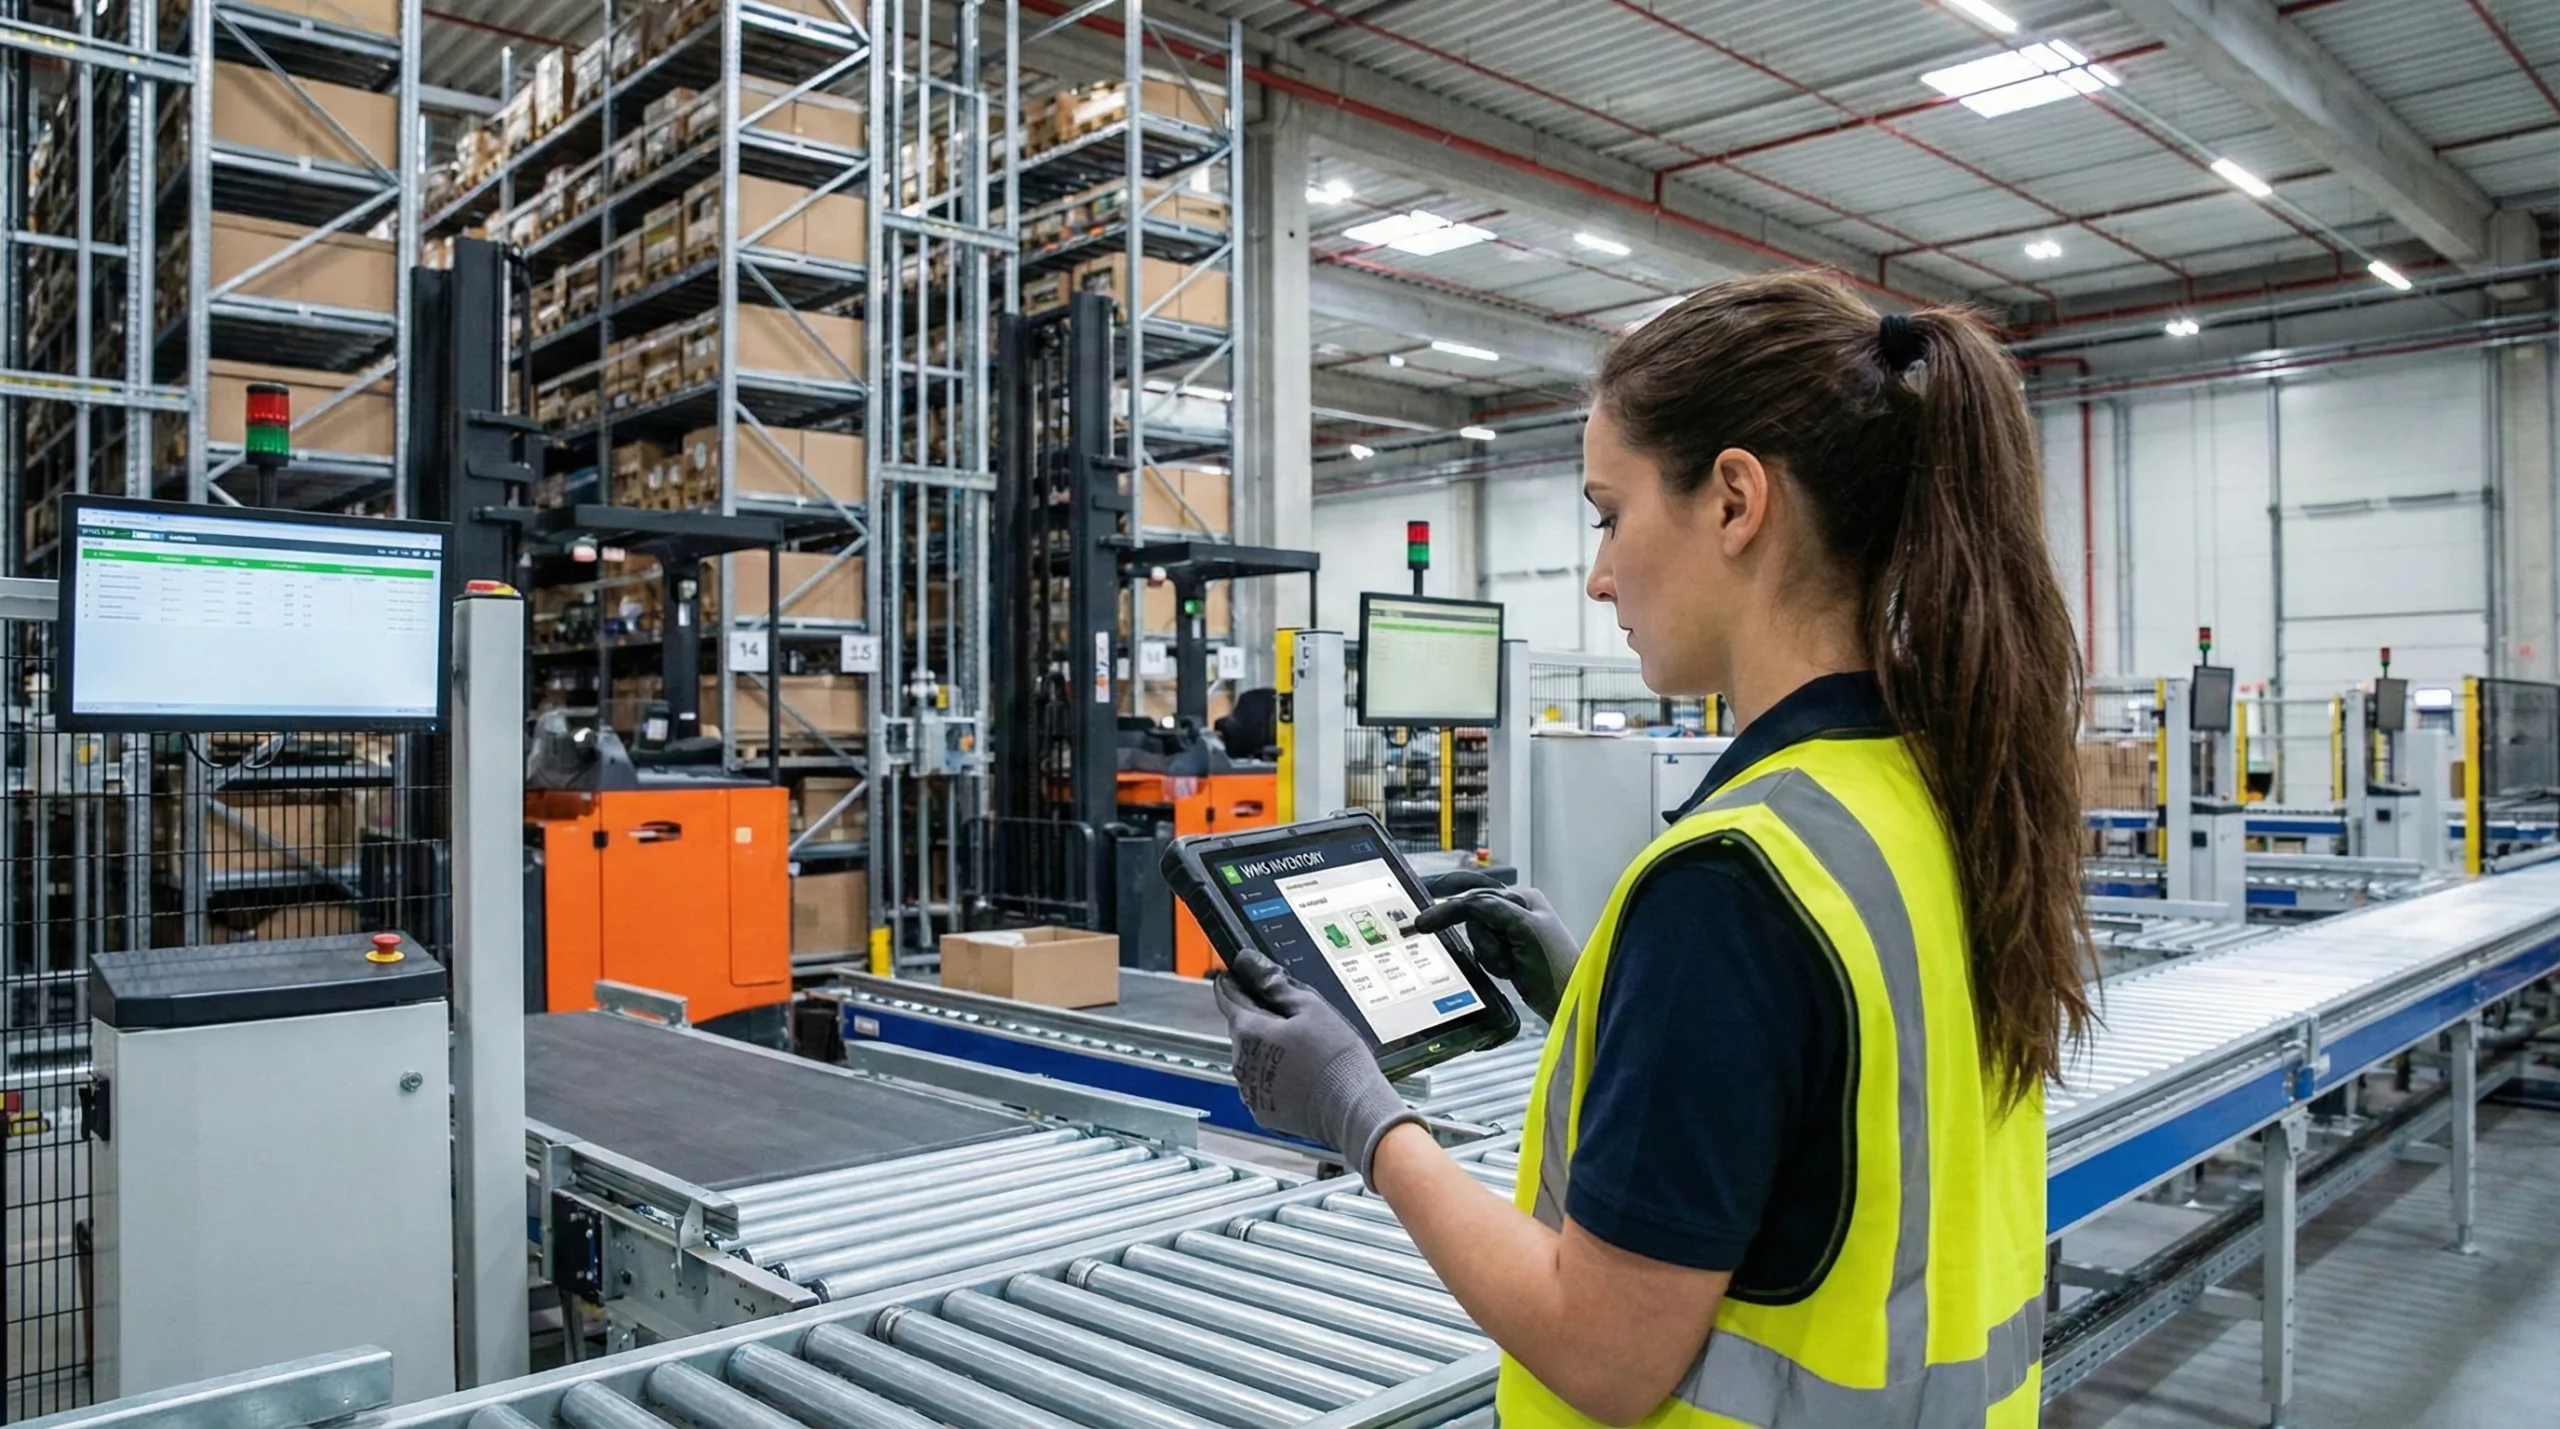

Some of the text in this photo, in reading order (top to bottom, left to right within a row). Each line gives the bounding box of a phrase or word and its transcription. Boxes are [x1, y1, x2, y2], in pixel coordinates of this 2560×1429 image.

[740, 640, 759, 657] 14
[851, 644, 872, 661] 15
[1239, 850, 1326, 879] WMS INVENTORY
